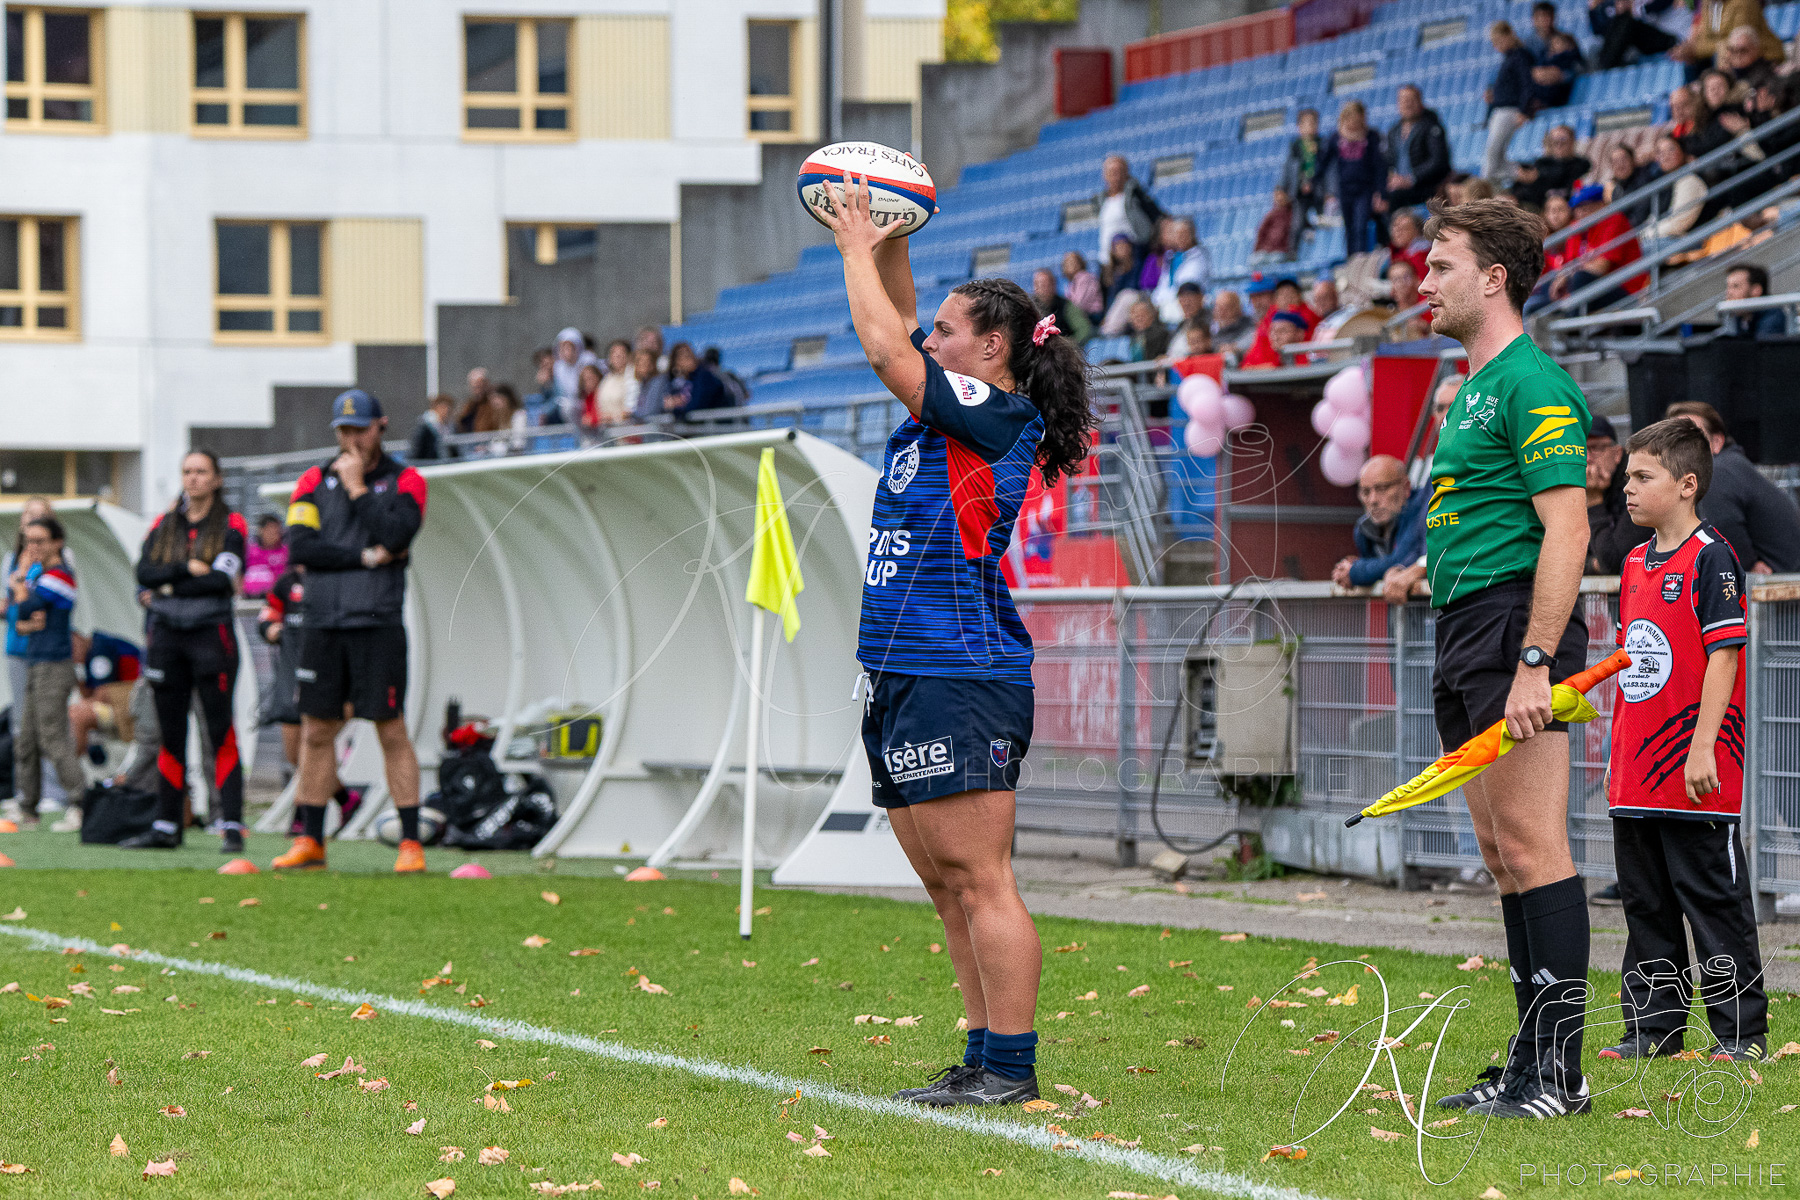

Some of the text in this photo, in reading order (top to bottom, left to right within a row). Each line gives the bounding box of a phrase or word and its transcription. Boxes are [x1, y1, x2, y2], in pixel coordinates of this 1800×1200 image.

[822, 146, 876, 157] FRAICA
[809, 190, 918, 227] GILRT
[1524, 444, 1585, 464] LA POSTE
[1426, 512, 1460, 529] OSTE
[865, 560, 898, 587] UP
